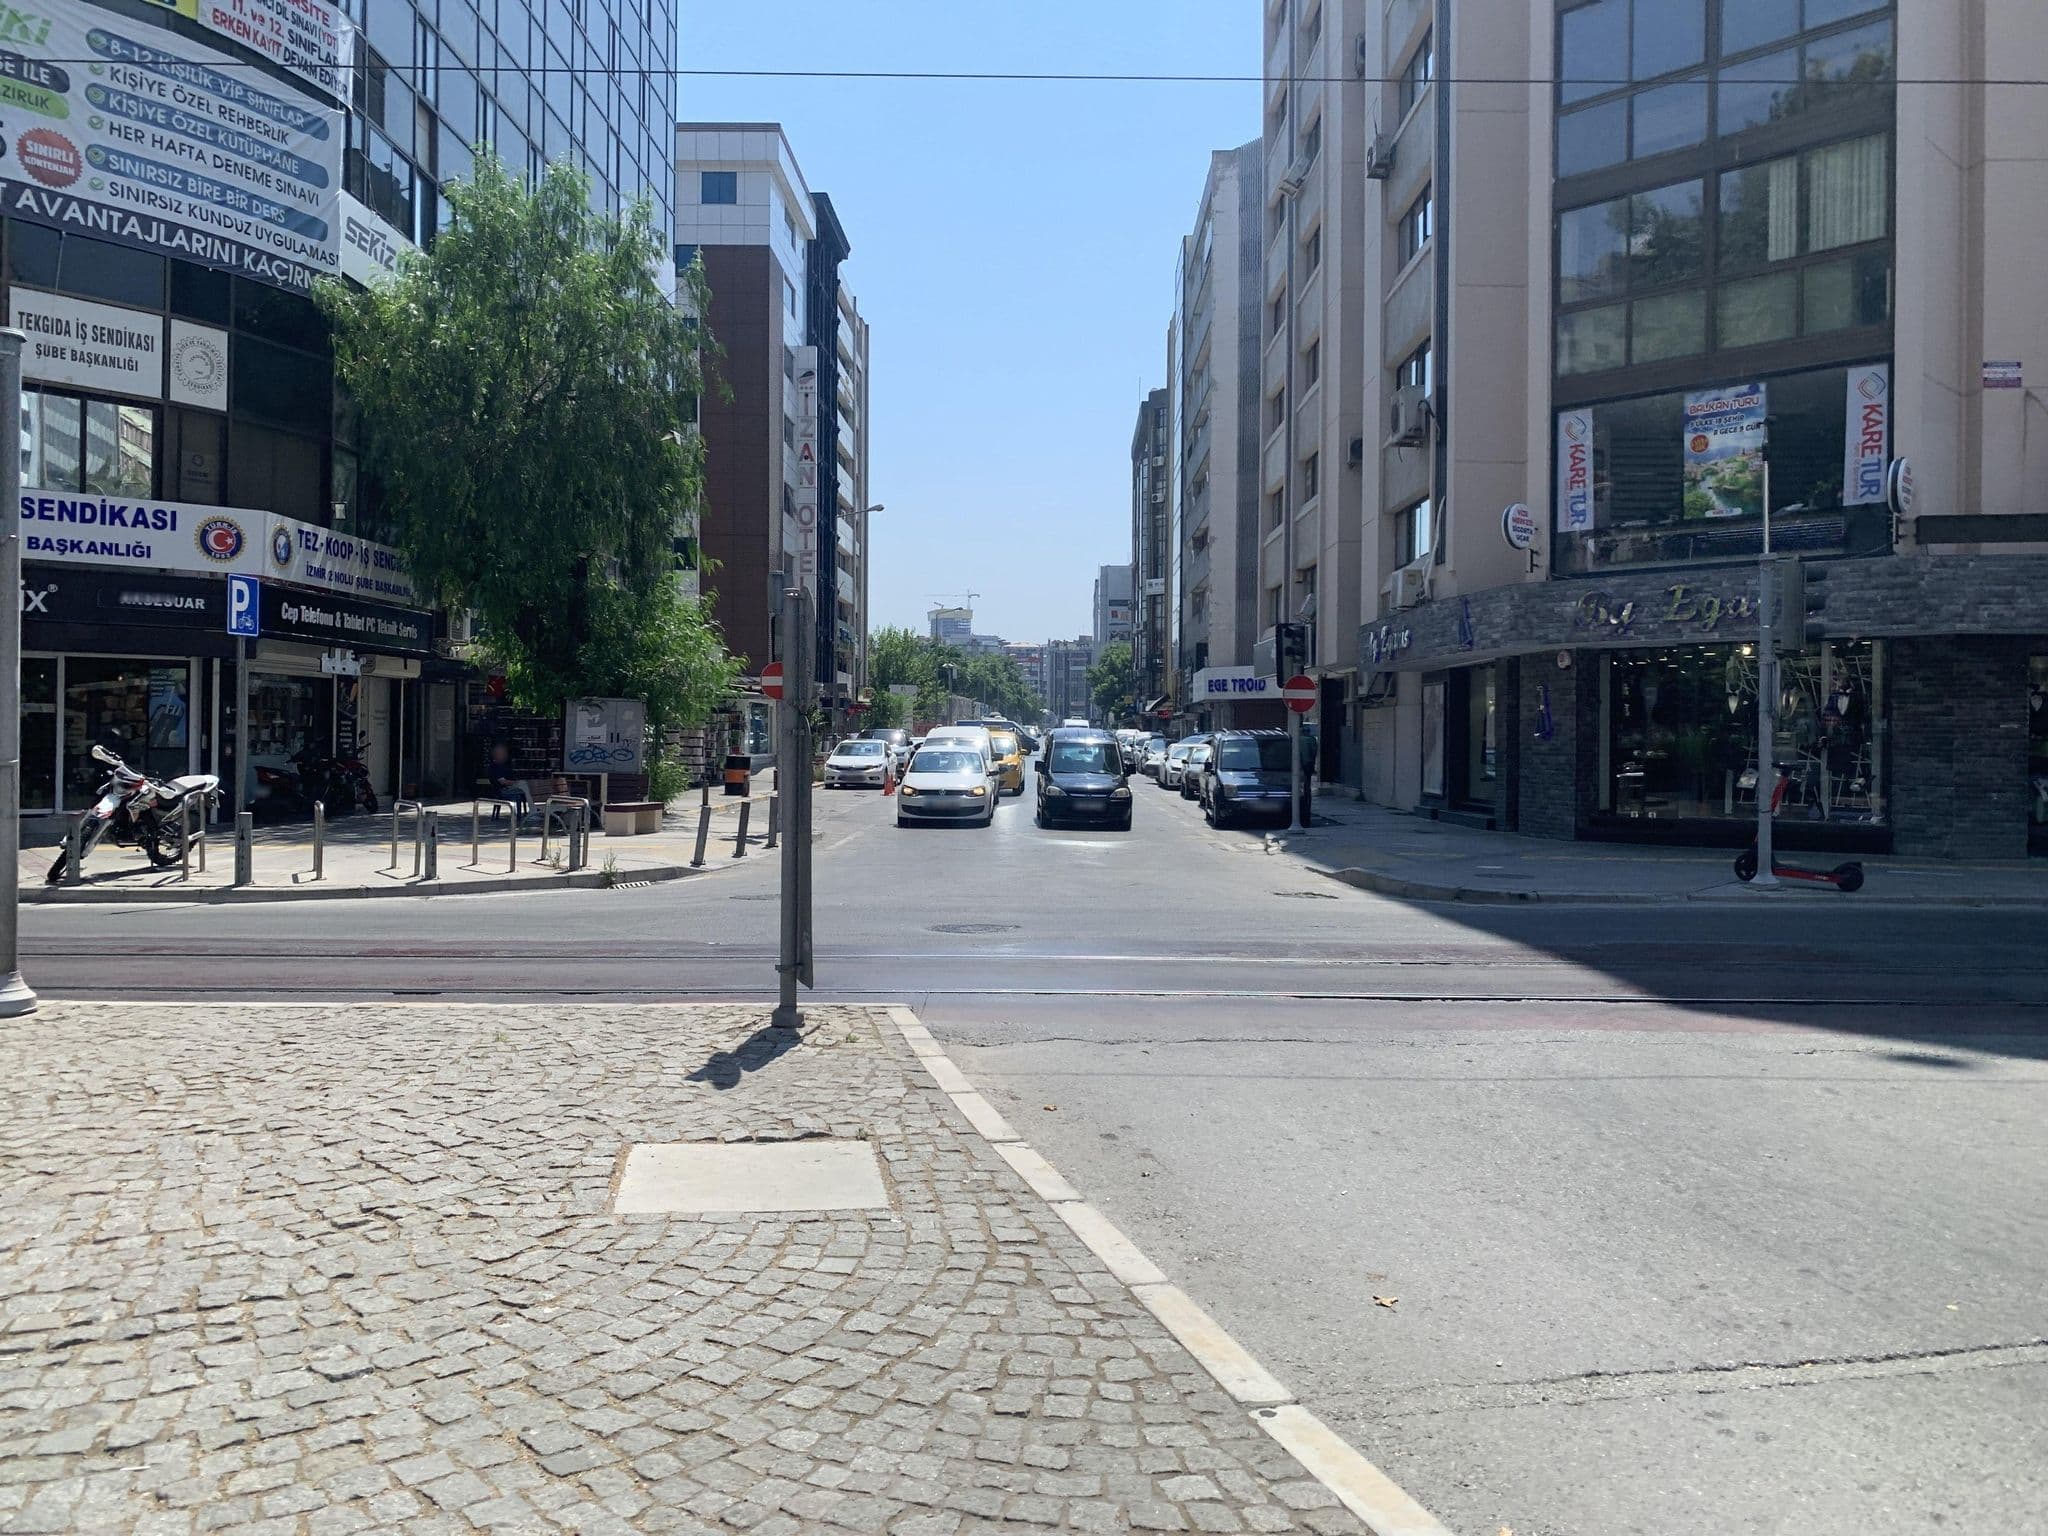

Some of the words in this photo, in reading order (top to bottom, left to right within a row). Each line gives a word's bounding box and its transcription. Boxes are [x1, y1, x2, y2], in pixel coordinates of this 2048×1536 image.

[212, 8, 250, 40] ERKEN
[253, 26, 282, 57] KAYIT
[283, 47, 318, 79] DEVAM
[251, 9, 265, 26] ve
[269, 17, 285, 39] 12.
[291, 11, 319, 37] SINAVI
[109, 66, 167, 97] KİŞİYE
[173, 84, 214, 114] ÖZEL
[219, 107, 290, 145] REHBERLİK
[158, 54, 215, 88] KİŞİLİK
[218, 78, 244, 99] VİP
[247, 91, 304, 128] SINIFLAR
[109, 92, 167, 124] KİŞİYE
[172, 110, 214, 141] ÖZEL
[218, 128, 300, 175] KÜTÜPHANE
[109, 121, 145, 144] HER
[151, 134, 208, 165] HAFTA
[213, 154, 272, 188] DENEME
[276, 178, 319, 206] SINAVI
[109, 154, 182, 189] SINIRSIZ
[187, 177, 221, 200] BİRE
[226, 189, 248, 209] BİR
[252, 200, 286, 224] DERS
[15, 188, 237, 266] AVANTAJLARINI
[109, 181, 183, 214] SINIRSIZ
[188, 203, 252, 236] KUNDUZ
[256, 225, 340, 267] UYGULAMASI
[18, 311, 71, 338] TEKGIDA
[75, 318, 88, 345] İŞ
[92, 324, 155, 352] SENDİKASI
[35, 343, 66, 360] ŞUBE
[70, 350, 139, 372] BAŞKANLIĞI
[1689, 399, 1729, 415] BALKAN
[1731, 395, 1760, 409] TURU
[21, 496, 177, 531] SENDİKASI
[26, 535, 152, 559] BAŞKANLIĞI
[231, 579, 250, 630] P
[281, 601, 299, 624] Cep
[300, 605, 334, 627] Telefonu
[334, 611, 342, 628] &
[1207, 679, 1228, 693] EGE
